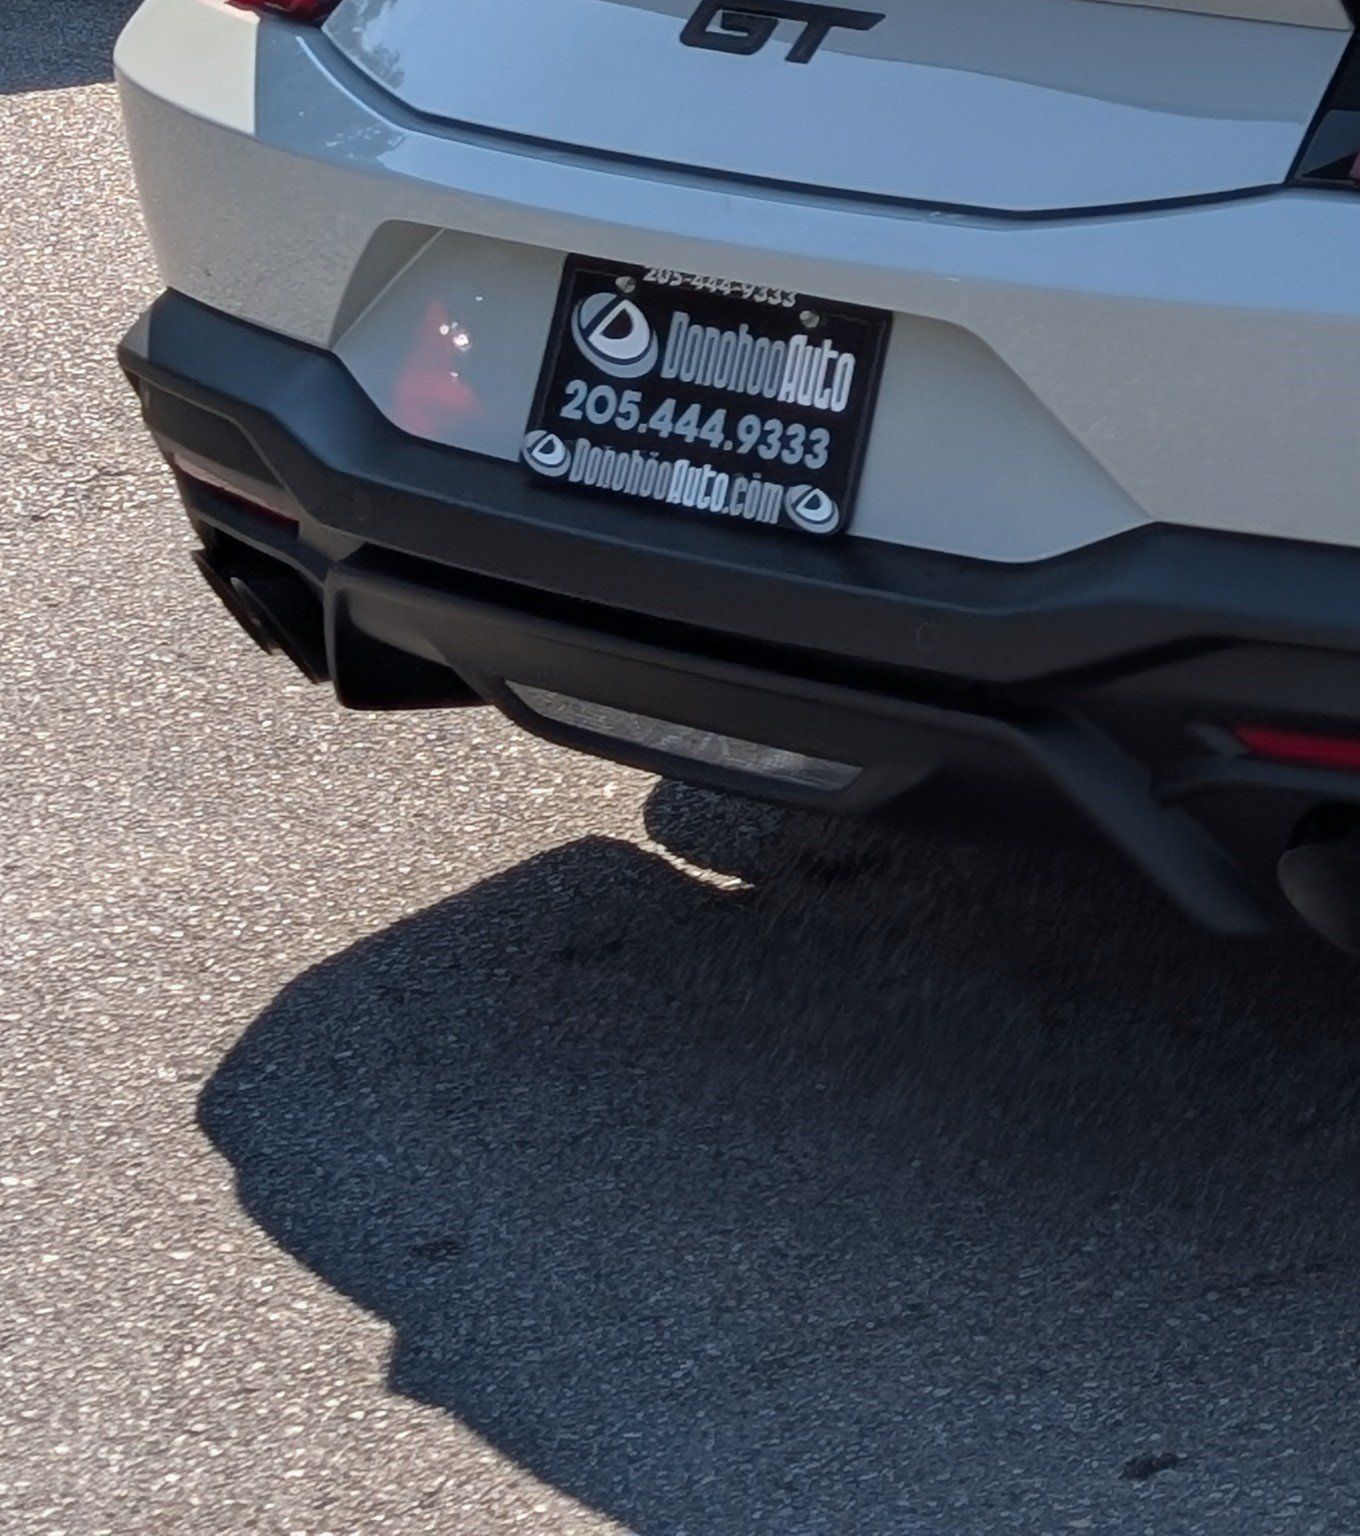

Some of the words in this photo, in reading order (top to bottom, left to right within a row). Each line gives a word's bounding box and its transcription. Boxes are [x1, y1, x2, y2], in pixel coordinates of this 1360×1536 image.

[660, 311, 856, 413] DonohooAuto
[559, 379, 830, 470] 205.444.9333
[568, 438, 784, 524] DonohooAuto.com
